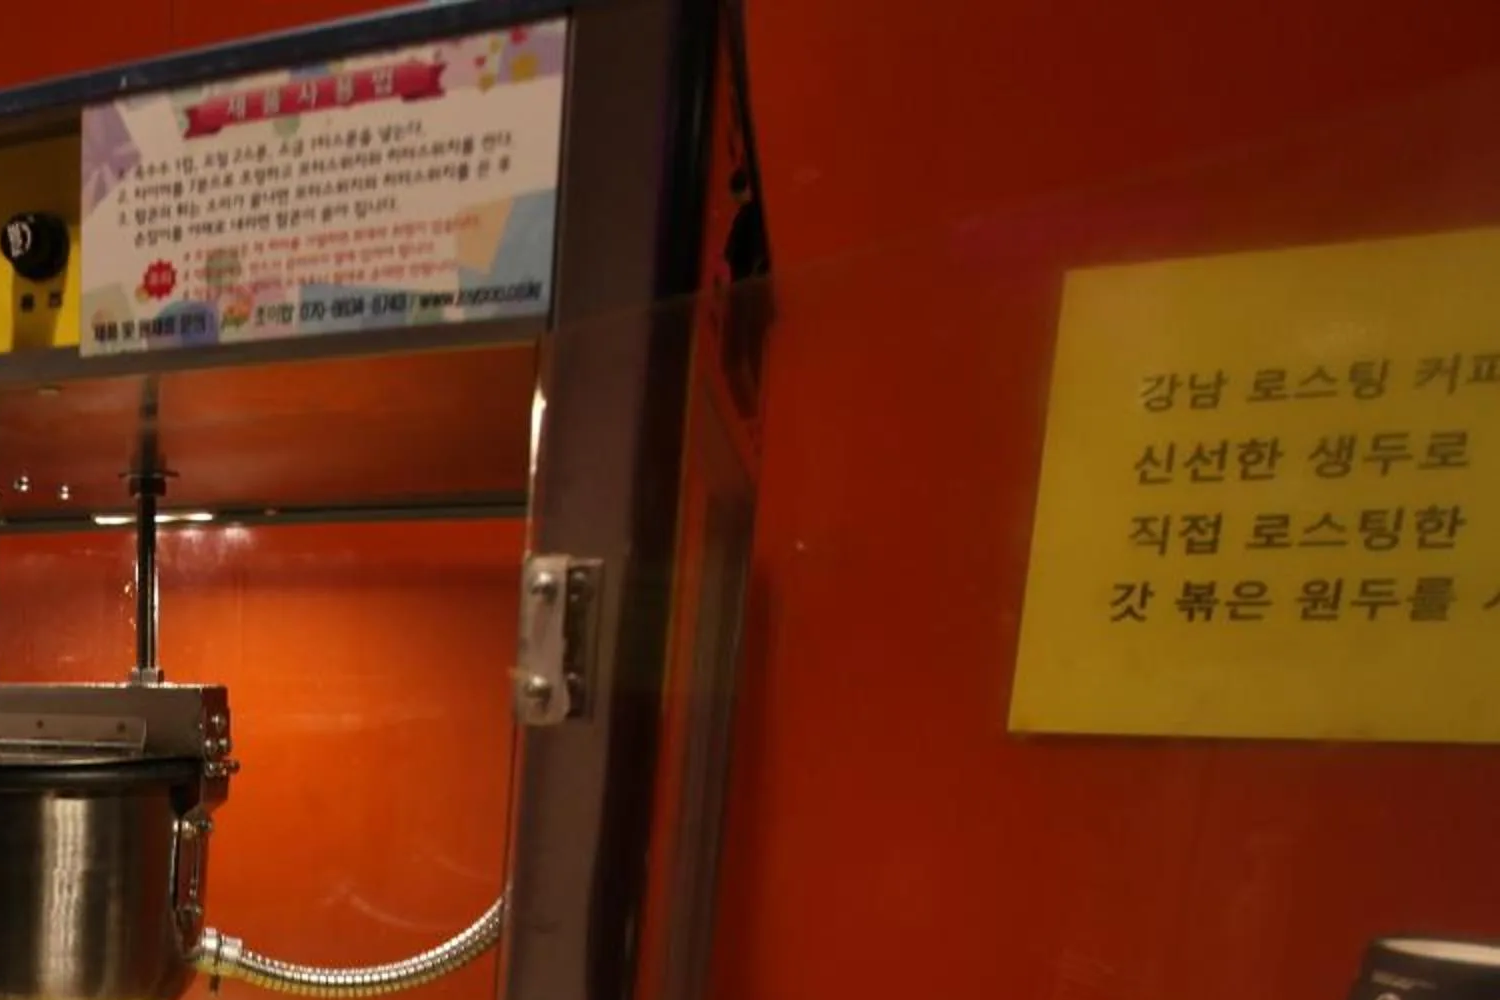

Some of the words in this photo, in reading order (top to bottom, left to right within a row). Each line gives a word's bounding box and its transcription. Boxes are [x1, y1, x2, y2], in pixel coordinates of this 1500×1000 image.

[1141, 369, 1228, 412] 강남
[1246, 358, 1390, 402] 로스팅
[1133, 437, 1284, 486] 신선한
[1307, 431, 1471, 479] 생두로
[1128, 512, 1224, 557] 직접
[1245, 505, 1467, 552] 로스팅한
[1108, 580, 1156, 622] 갓
[1175, 579, 1272, 622] 볶은
[1295, 577, 1457, 622] 원두를
